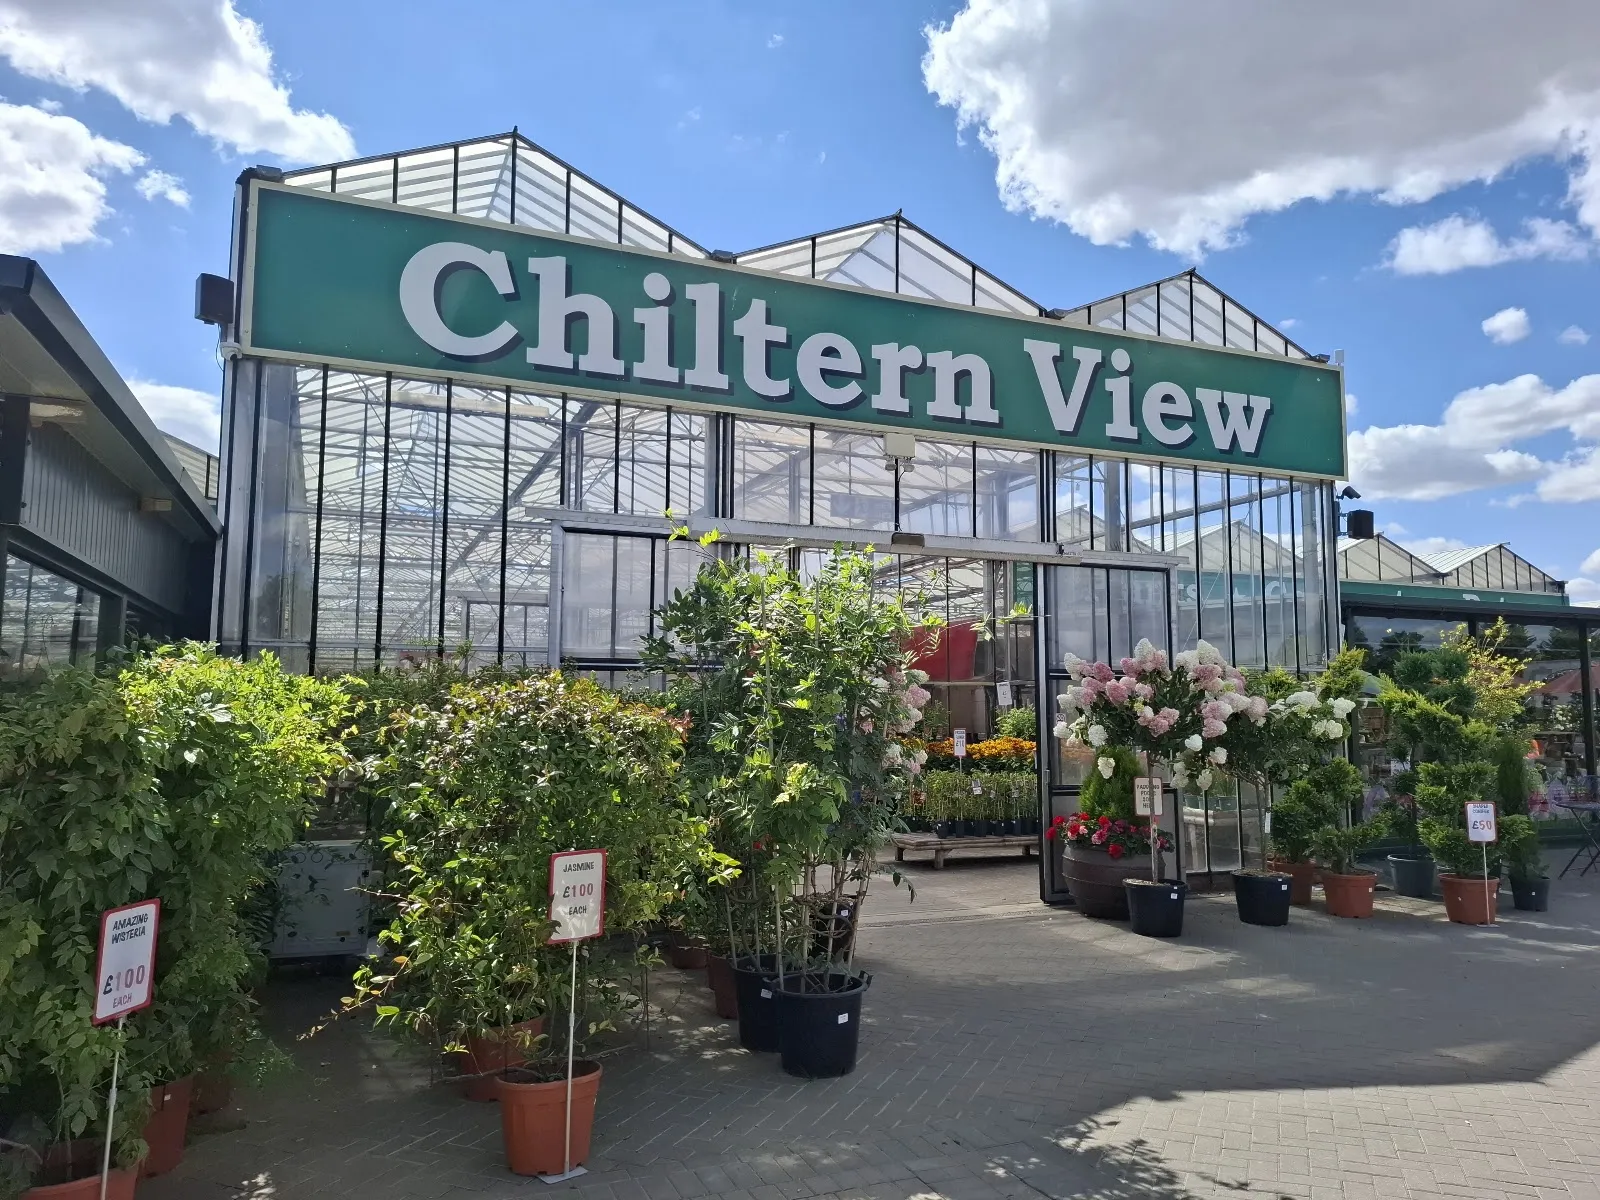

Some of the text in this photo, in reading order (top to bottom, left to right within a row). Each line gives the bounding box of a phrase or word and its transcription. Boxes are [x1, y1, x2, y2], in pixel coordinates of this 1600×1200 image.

[399, 241, 1274, 455] Chiltern View
[1472, 820, 1492, 830] £50
[563, 862, 594, 872] JASMINE
[563, 883, 593, 898] £100
[568, 905, 587, 915] EACH
[112, 913, 148, 931] AMAZING
[112, 926, 146, 944] WISTERIA
[103, 965, 145, 995] £100
[112, 993, 132, 1008] EACH
